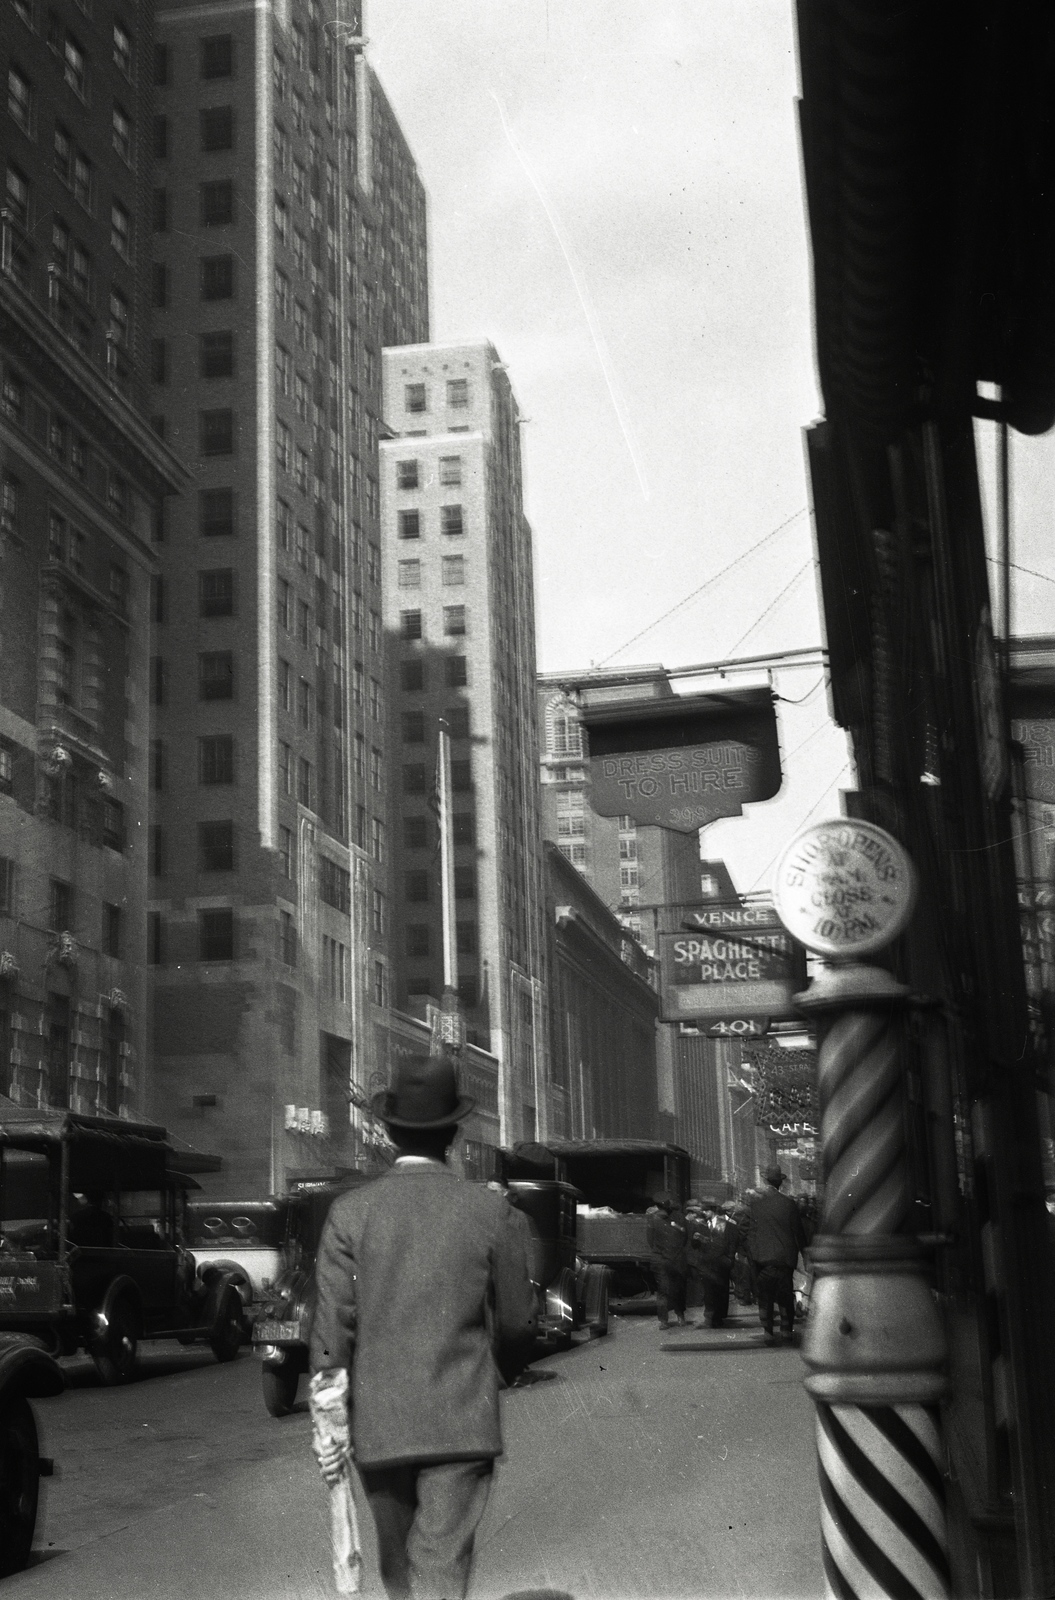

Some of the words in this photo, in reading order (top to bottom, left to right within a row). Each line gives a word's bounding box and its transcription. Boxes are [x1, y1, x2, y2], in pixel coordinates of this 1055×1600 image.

[603, 752, 683, 777] DRESS
[692, 745, 760, 768] SUITS
[618, 777, 659, 799] TO
[669, 767, 743, 794] HIRE
[786, 833, 830, 887] SHOP
[838, 829, 898, 883] OPENS
[693, 910, 769, 924] VENICE
[673, 935, 787, 962] SPAGHETTI
[701, 961, 760, 980] PLACE
[710, 1020, 755, 1033] 401
